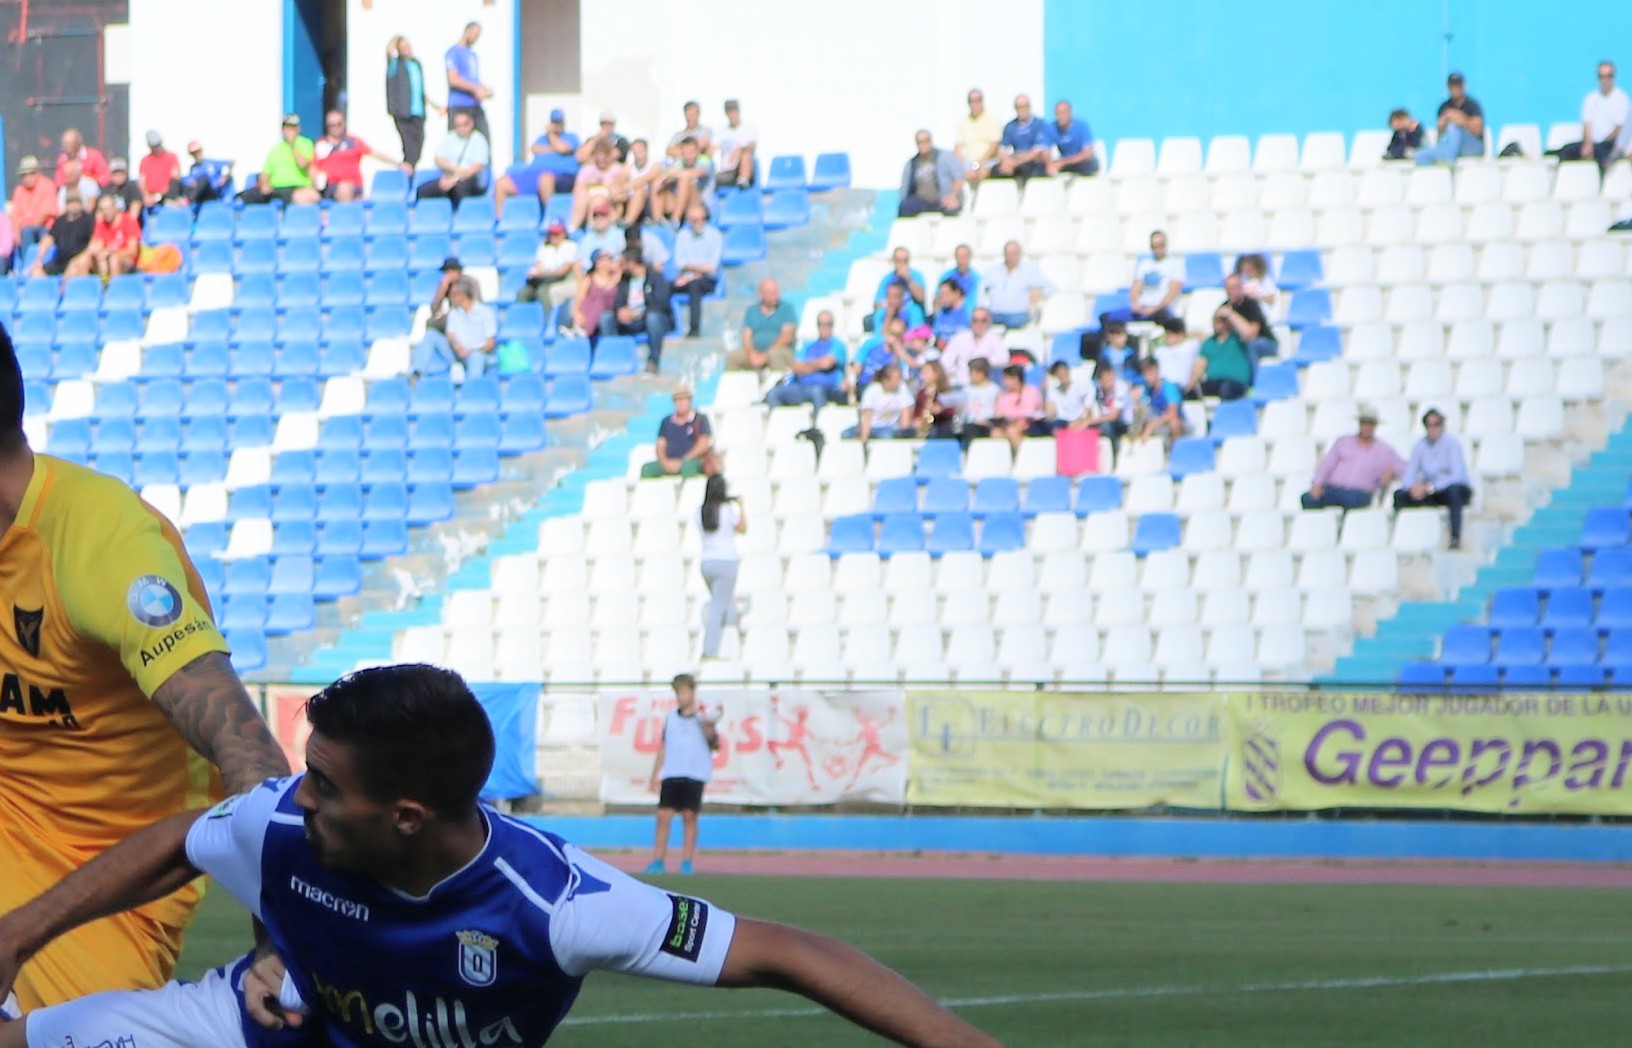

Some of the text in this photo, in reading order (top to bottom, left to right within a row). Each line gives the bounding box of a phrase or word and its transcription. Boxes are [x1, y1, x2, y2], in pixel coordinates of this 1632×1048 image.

[1354, 695, 1429, 715] MEJOR
[1435, 695, 1539, 717] JUGADOR
[1546, 697, 1575, 717] DE
[1583, 697, 1611, 717] LA
[290, 875, 370, 922] macron
